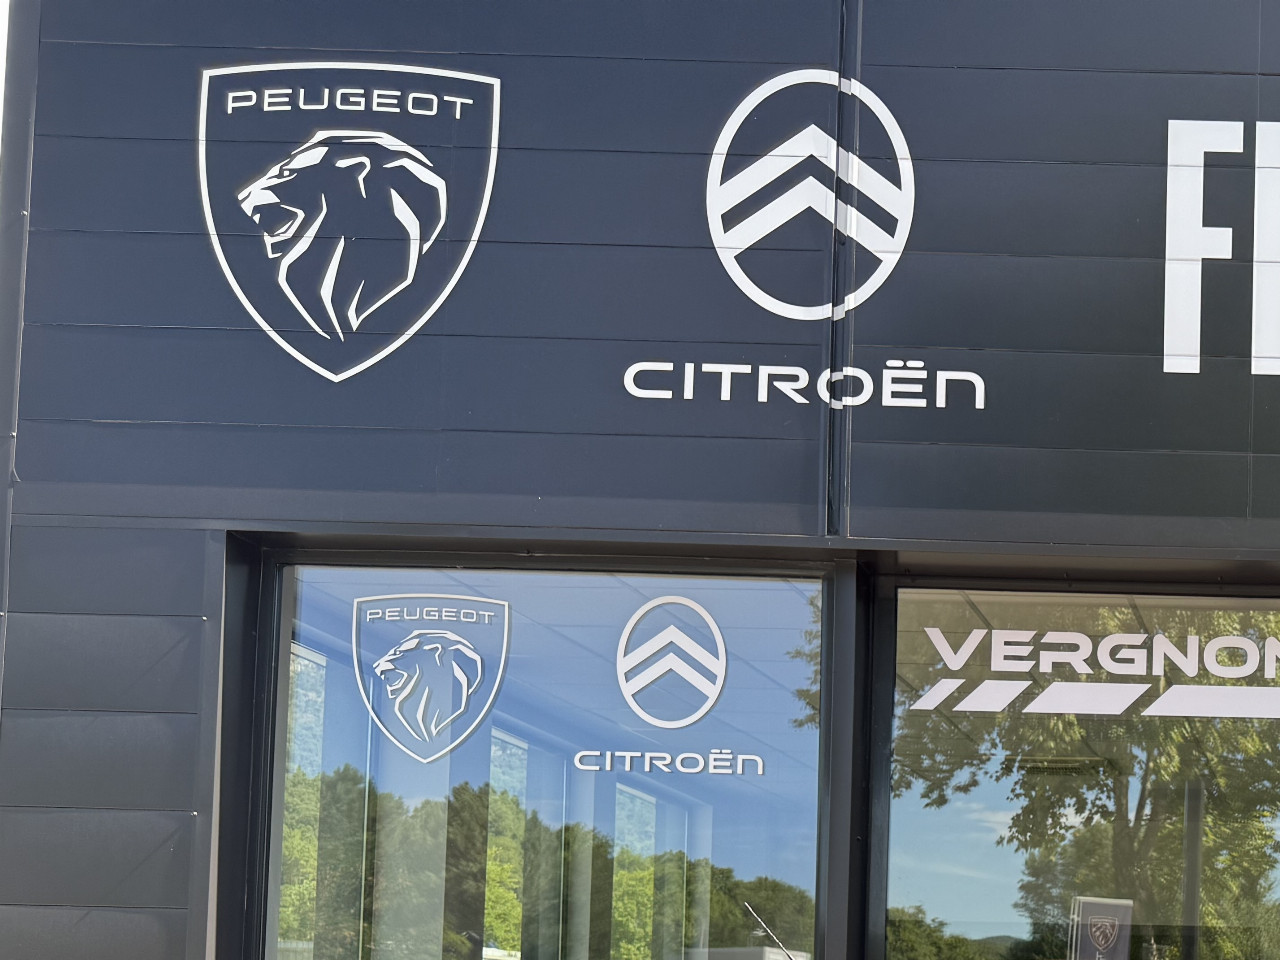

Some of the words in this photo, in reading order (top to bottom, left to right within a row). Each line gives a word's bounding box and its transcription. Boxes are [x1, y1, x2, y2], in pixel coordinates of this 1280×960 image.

[226, 86, 475, 119] PEUGEOT
[623, 359, 985, 410] CITROËN
[366, 606, 495, 624] PEUGEOT
[573, 748, 765, 776] CITROËN
